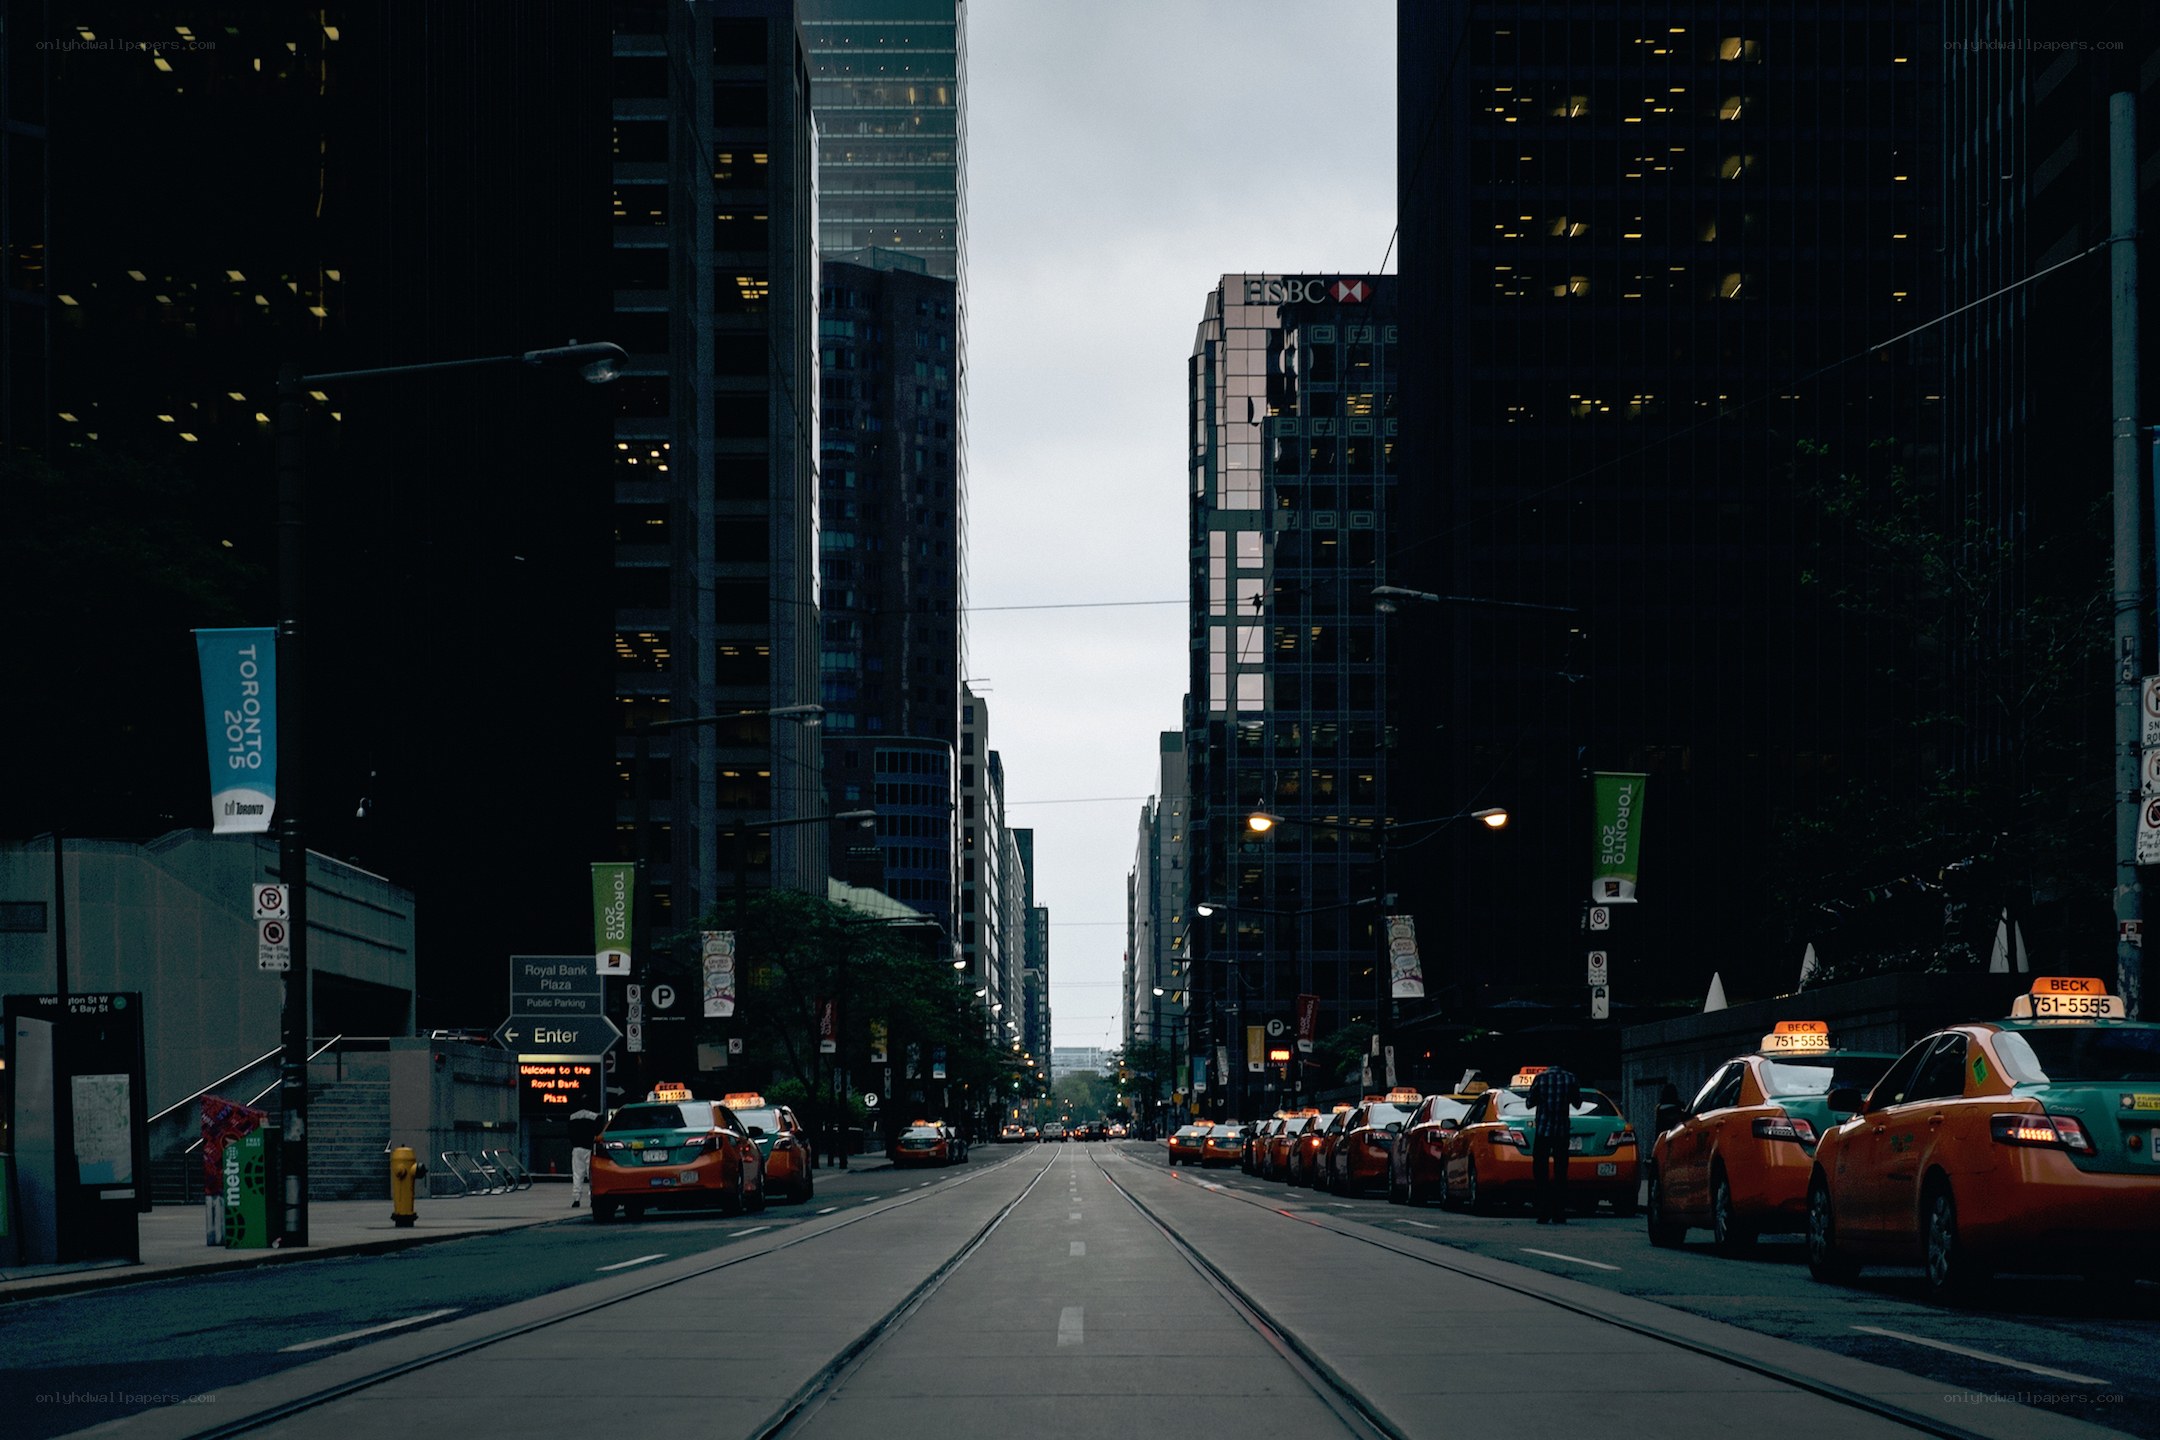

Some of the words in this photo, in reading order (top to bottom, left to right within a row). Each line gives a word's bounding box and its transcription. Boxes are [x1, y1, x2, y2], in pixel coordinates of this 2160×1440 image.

[1244, 279, 1326, 304] HSBC
[238, 643, 263, 770] TORONTO
[224, 709, 246, 770] 2015
[236, 801, 264, 816] TORONTO
[1613, 783, 1633, 865] TORONTO
[1601, 824, 1616, 865] 2015
[613, 871, 625, 940] TORONTO
[604, 906, 616, 940] 2015
[525, 965, 556, 978] Royal
[559, 965, 588, 976] Bank
[540, 979, 572, 990] Plaza
[2051, 980, 2090, 991] BECK
[39, 995, 86, 1006] Wellton
[87, 995, 97, 1004] St
[98, 995, 109, 1004] W
[526, 998, 552, 1008] Public
[554, 998, 586, 1010] Parking
[2033, 997, 2111, 1014] 751-5555
[70, 1005, 78, 1014] &
[79, 1005, 97, 1015] Bay
[98, 1004, 109, 1013] St
[1787, 1023, 1816, 1032] BECK
[534, 1027, 579, 1044] Enter
[520, 1065, 556, 1075] Welcome
[558, 1065, 571, 1075] to
[573, 1065, 592, 1075] the
[531, 1079, 556, 1089] Royal
[557, 1079, 580, 1089] Bank
[543, 1093, 568, 1103] Plaza
